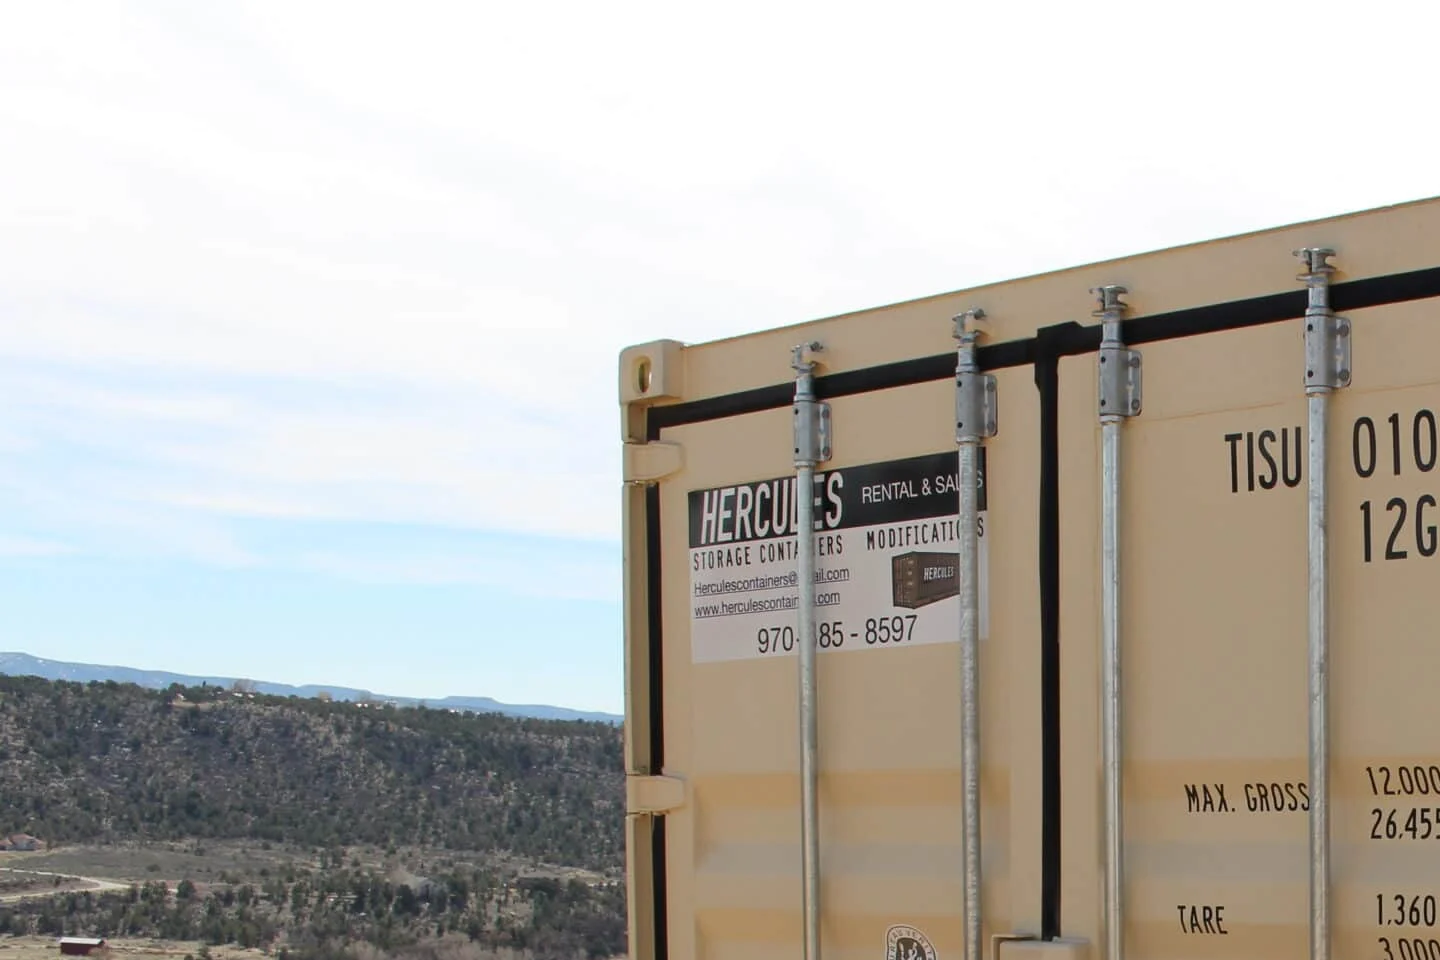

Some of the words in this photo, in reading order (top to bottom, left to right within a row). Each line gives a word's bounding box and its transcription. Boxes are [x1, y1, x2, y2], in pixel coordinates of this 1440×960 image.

[1224, 426, 1302, 493] TISU
[862, 480, 918, 504] RENTAL
[922, 478, 932, 496] &
[693, 546, 751, 572] STORAGE
[865, 615, 918, 645] 8597
[1184, 783, 1236, 813] MAX.
[1245, 782, 1310, 812] GROSS
[1177, 905, 1228, 935] TARE
[1376, 893, 1436, 927] 1,360
